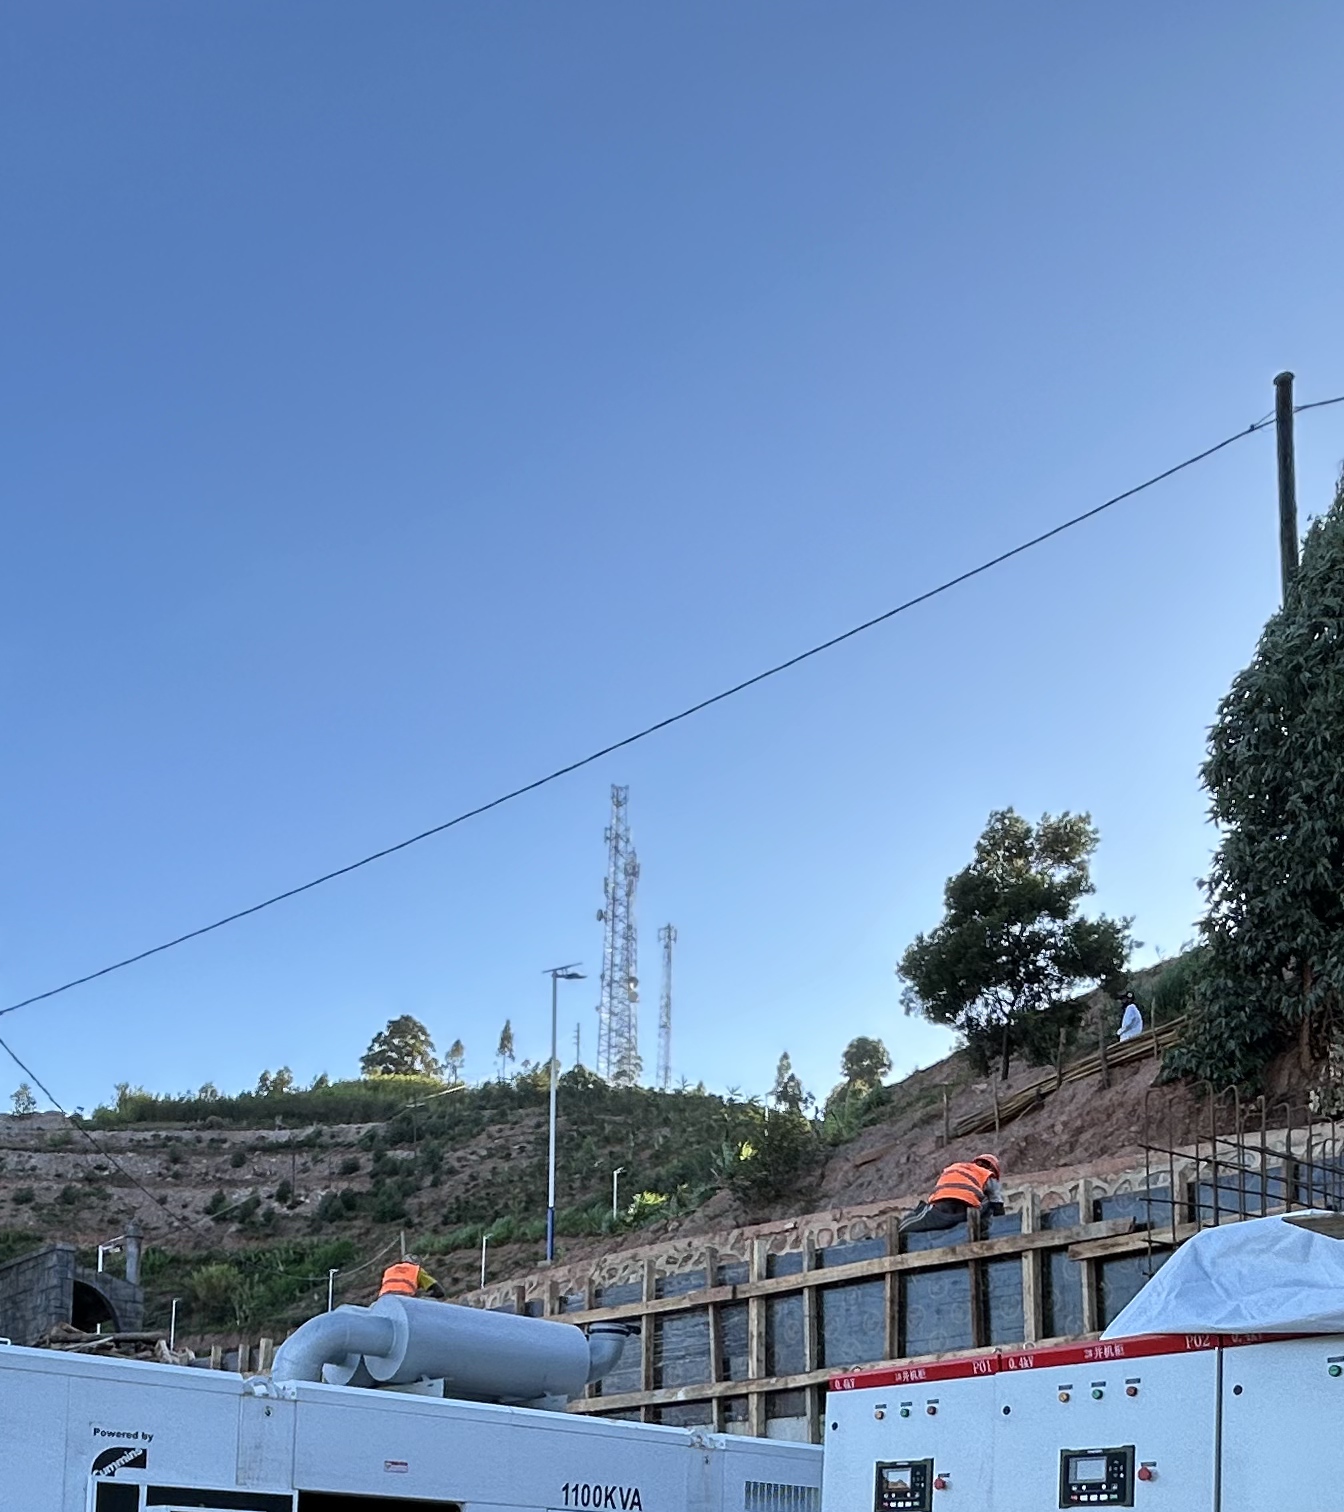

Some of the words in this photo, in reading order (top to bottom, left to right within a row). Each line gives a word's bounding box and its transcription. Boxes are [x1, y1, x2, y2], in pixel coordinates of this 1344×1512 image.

[1185, 1335, 1211, 1350] P02
[972, 1359, 992, 1375] P01
[1008, 1355, 1034, 1370] 0.4kV
[93, 1427, 139, 1440] Powered
[141, 1431, 154, 1443] by
[561, 1482, 643, 1512] 1100KVA
